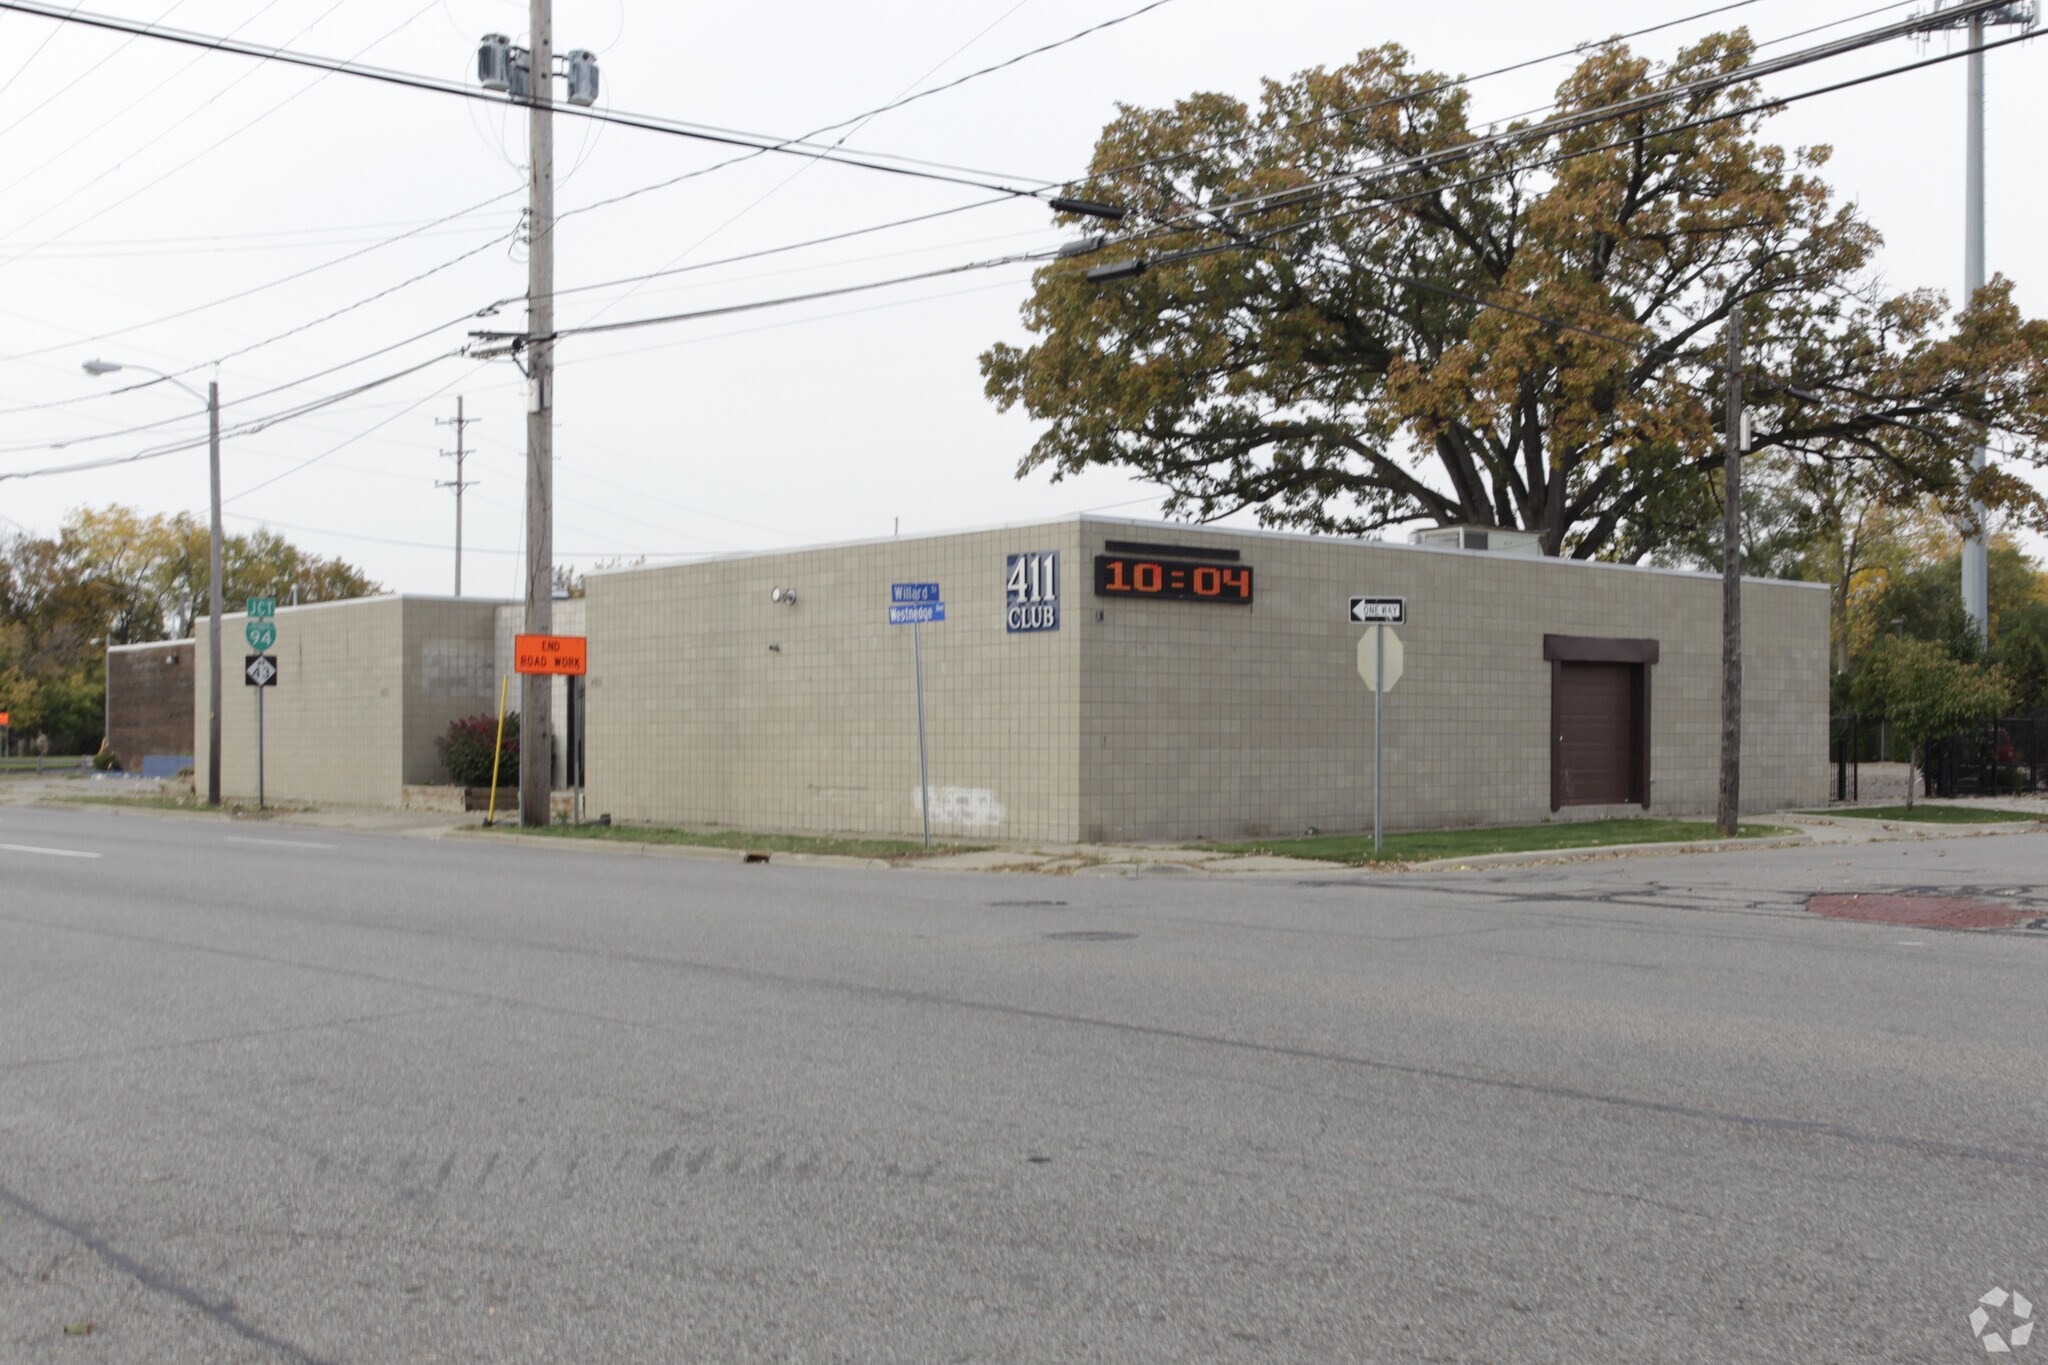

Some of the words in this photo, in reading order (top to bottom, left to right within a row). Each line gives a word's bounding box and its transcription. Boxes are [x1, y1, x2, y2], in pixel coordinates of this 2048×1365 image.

[1007, 554, 1057, 603] 411
[1106, 560, 1249, 598] 10:04
[894, 585, 928, 601] Willard
[250, 600, 274, 616] JCT
[890, 606, 932, 622] Westnedge
[1364, 604, 1378, 615] ONE
[1381, 604, 1398, 615] WAY
[1008, 604, 1055, 630] CLUB
[249, 629, 272, 647] 94
[541, 640, 560, 652] END
[520, 655, 547, 668] ROAD
[554, 656, 580, 669] WORK
